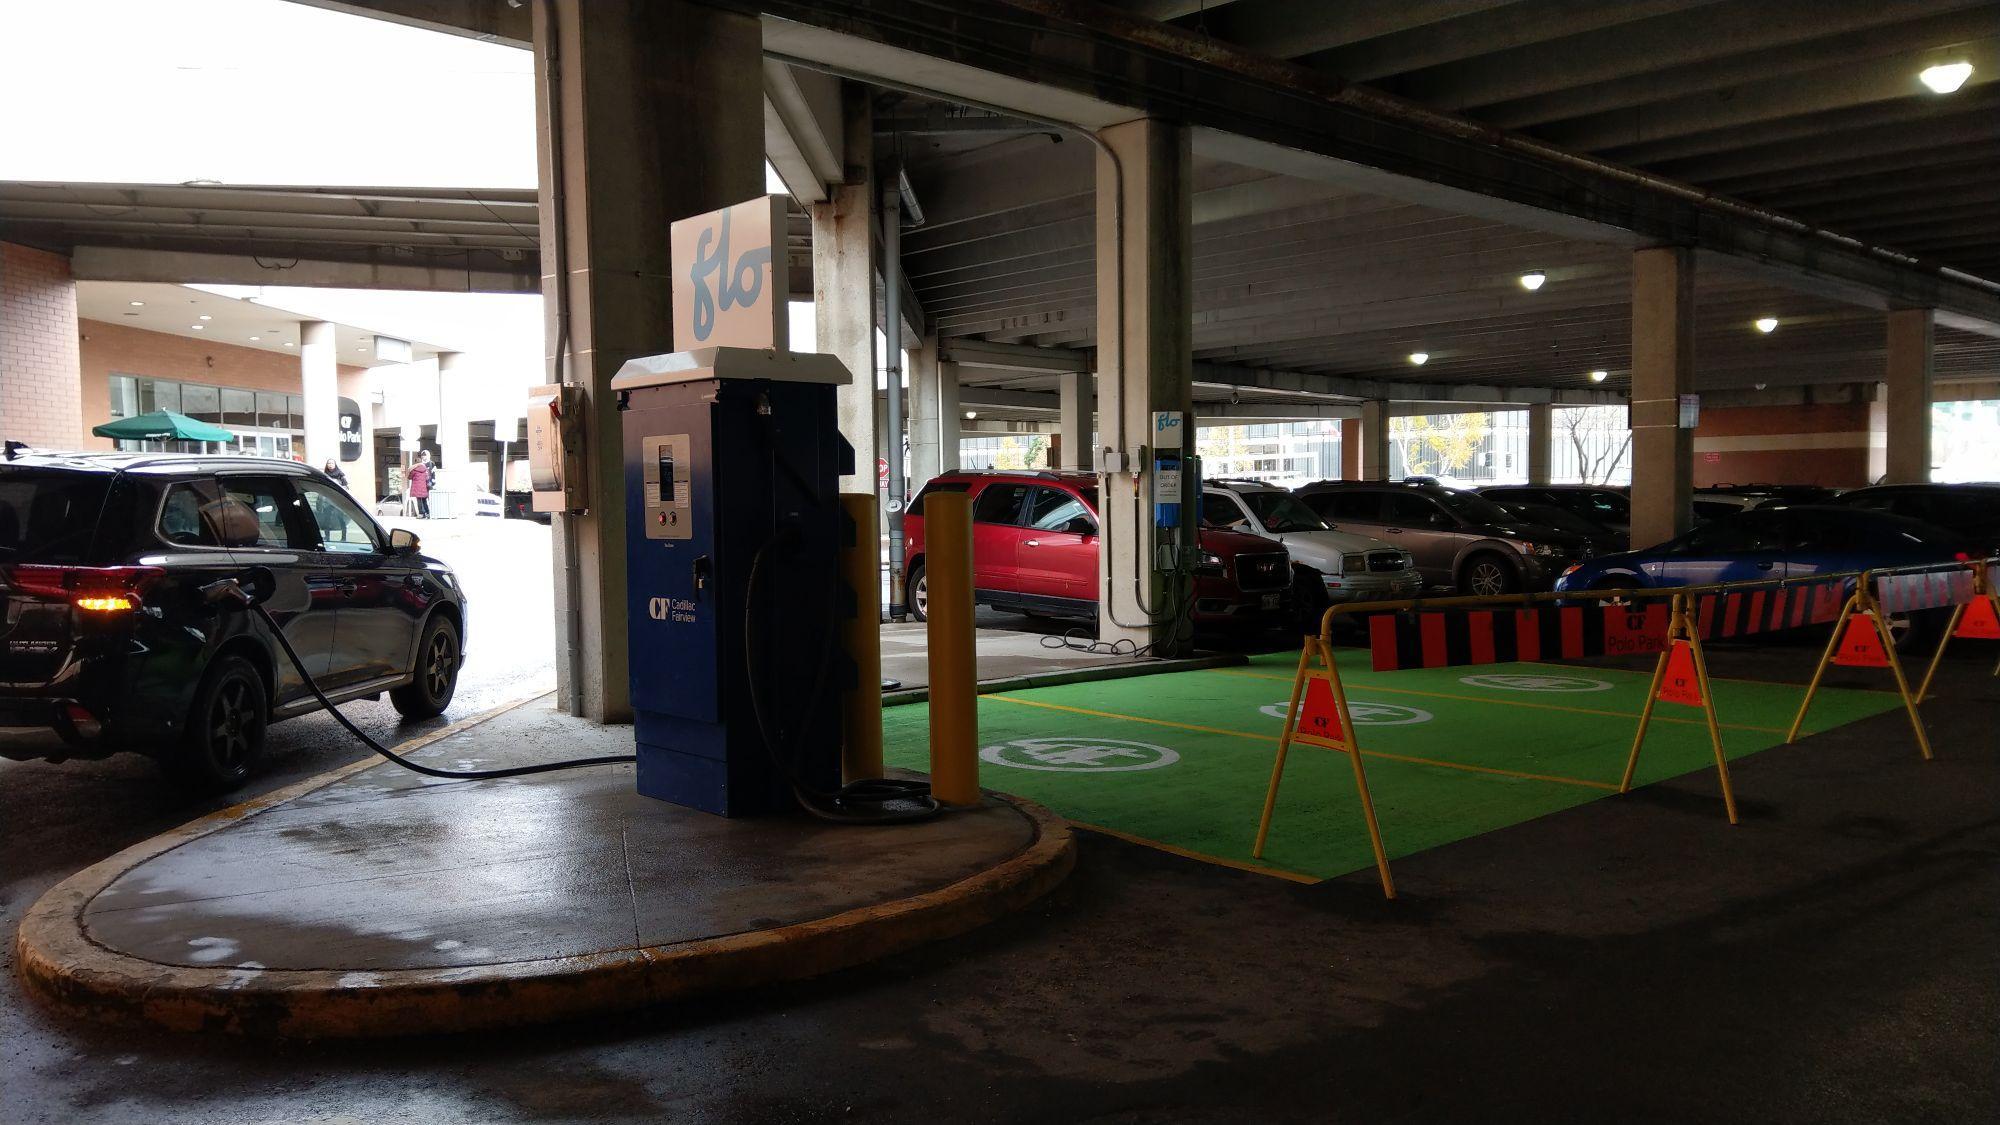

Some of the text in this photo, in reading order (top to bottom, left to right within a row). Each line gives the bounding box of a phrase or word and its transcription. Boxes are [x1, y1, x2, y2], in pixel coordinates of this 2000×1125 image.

[691, 208, 771, 341] flo
[1158, 412, 1180, 432] flo
[347, 431, 361, 443] Park
[649, 597, 671, 620] CF
[671, 599, 696, 611] Cadillac
[672, 611, 696, 622] Fairview
[1627, 615, 1648, 631] CF
[1608, 634, 1669, 652] Polo Park
[1315, 717, 1330, 728] CF
